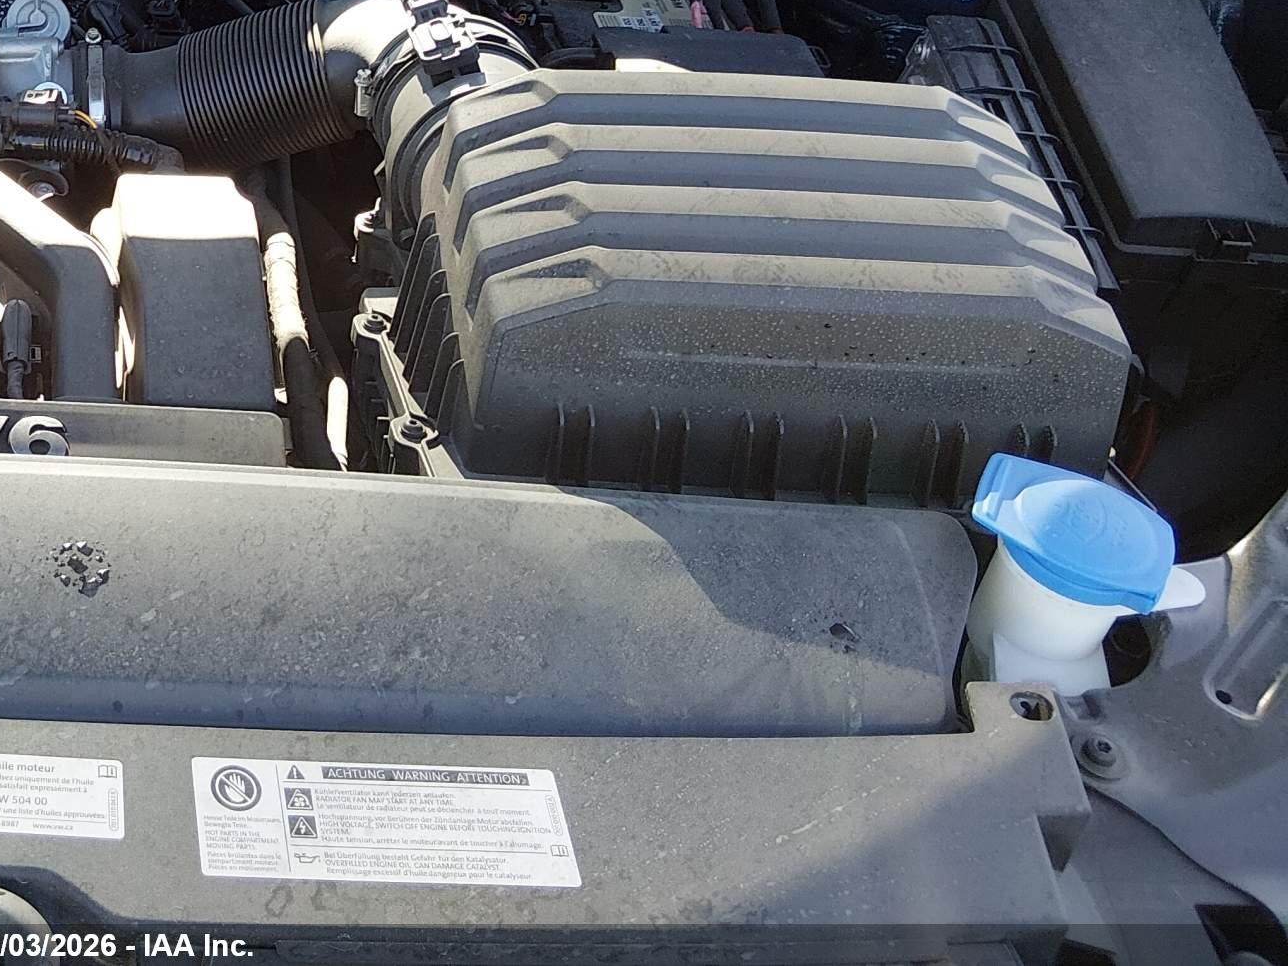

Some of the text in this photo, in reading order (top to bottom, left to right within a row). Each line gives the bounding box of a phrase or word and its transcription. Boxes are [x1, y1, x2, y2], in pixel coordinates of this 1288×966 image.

[17, 763, 55, 773] moteur
[328, 768, 521, 785] ACHTUNG WARNING ATTENTION
[12, 795, 31, 805] 504
[34, 797, 48, 806] 00
